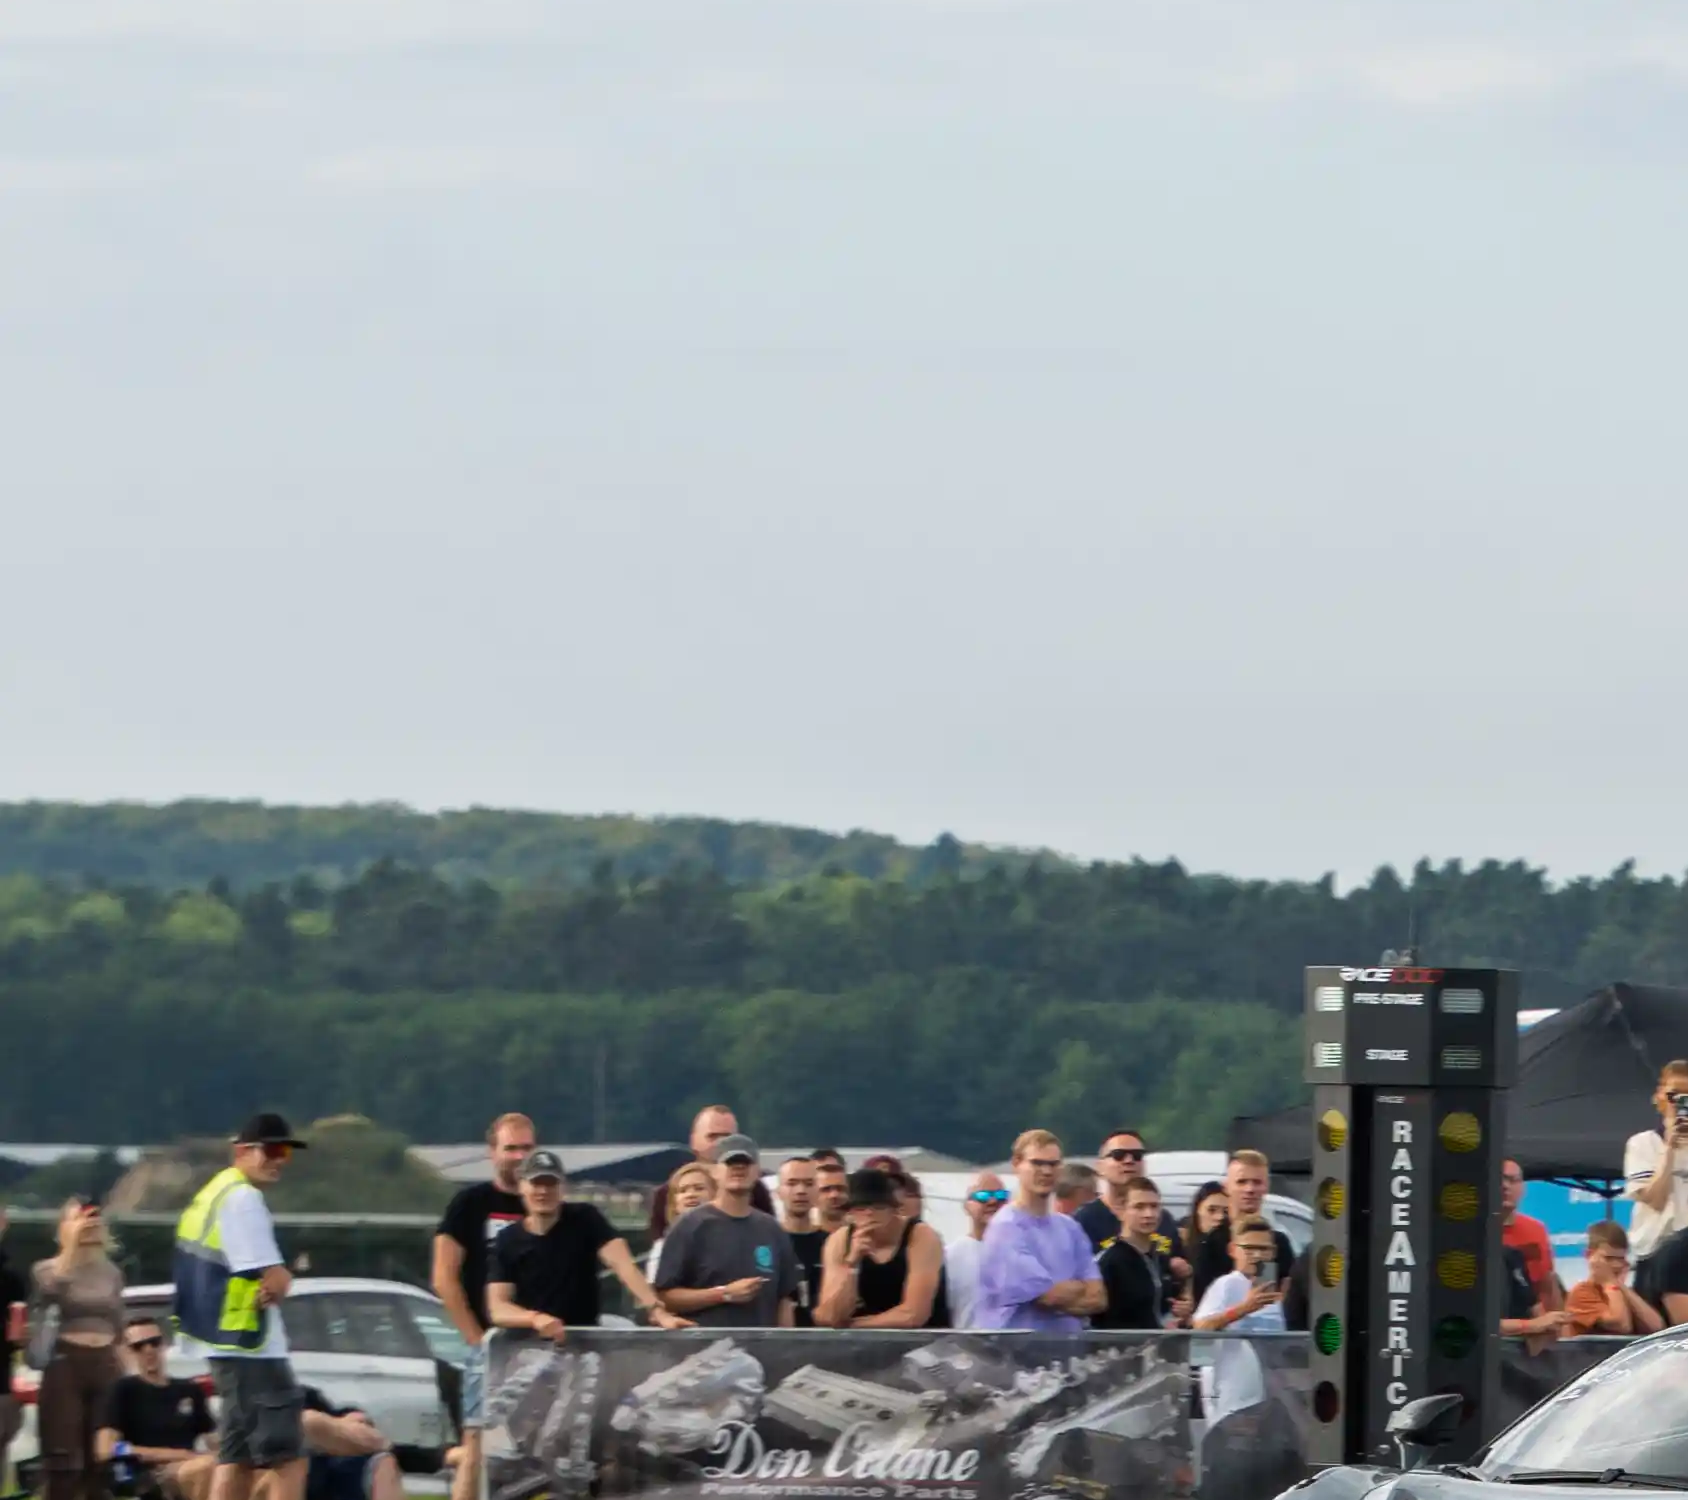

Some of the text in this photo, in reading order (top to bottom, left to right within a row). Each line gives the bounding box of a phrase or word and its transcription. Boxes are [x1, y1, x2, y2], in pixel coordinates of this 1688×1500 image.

[1365, 1049, 1409, 1061] STAGE
[702, 1419, 811, 1480] Don
[700, 1481, 979, 1500] Performance Parts
